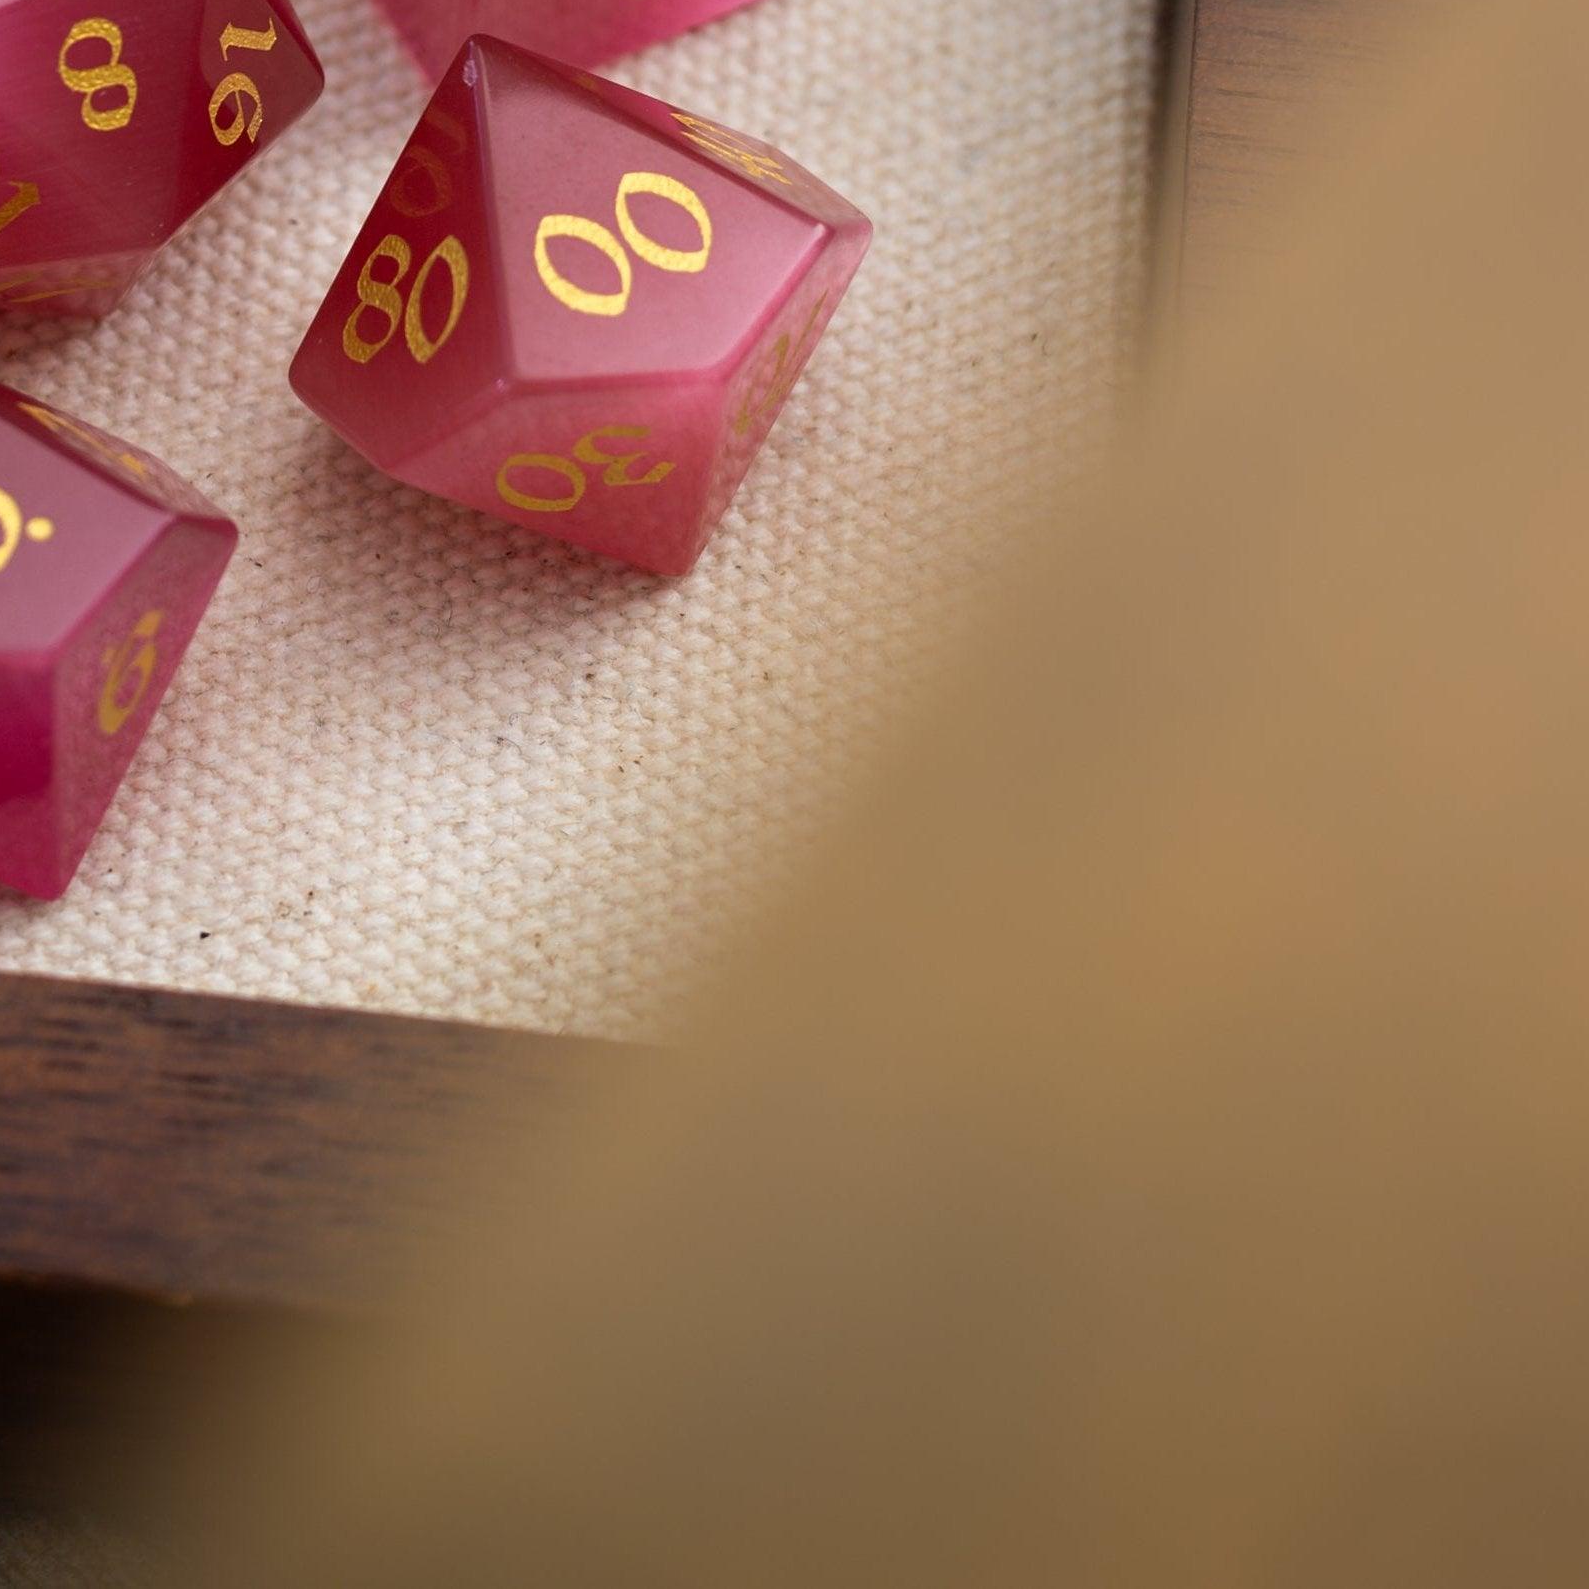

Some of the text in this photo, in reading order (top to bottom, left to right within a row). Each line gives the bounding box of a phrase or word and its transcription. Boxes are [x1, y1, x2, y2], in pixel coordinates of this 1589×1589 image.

[58, 17, 138, 132] 8
[208, 17, 278, 146] 16
[342, 234, 469, 364] 80
[534, 171, 712, 316] 00
[496, 426, 676, 512] 30
